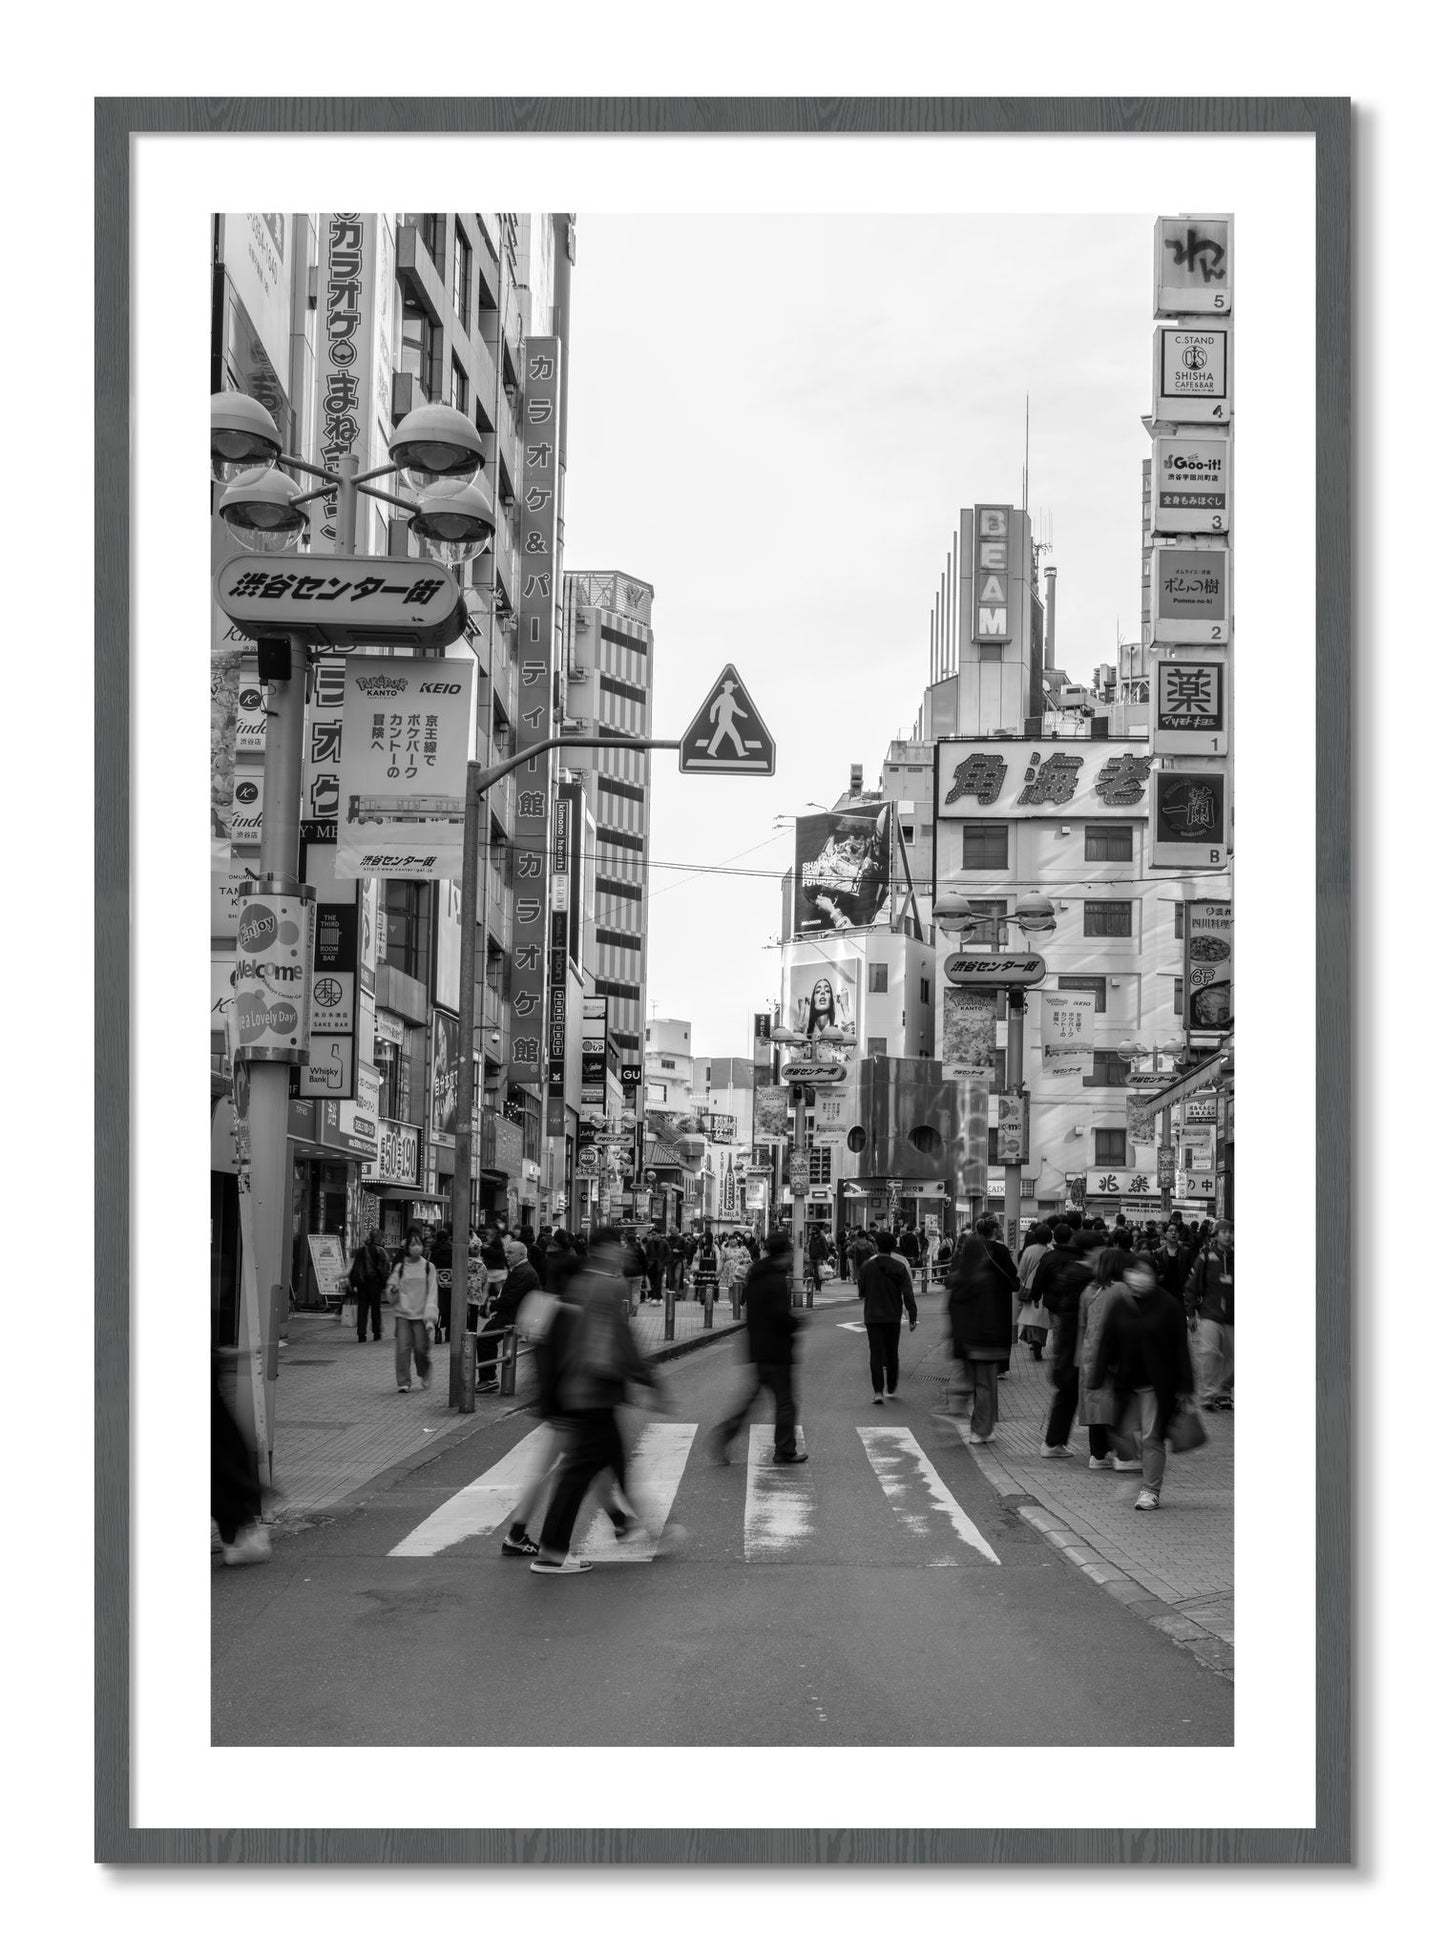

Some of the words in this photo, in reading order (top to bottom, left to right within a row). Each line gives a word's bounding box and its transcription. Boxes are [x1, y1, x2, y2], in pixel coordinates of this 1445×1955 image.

[328, 221, 364, 341] カラオケ
[1214, 295, 1224, 307] 5
[1175, 336, 1214, 344] C.STAND
[1175, 372, 1214, 380] SHISHA
[1213, 405, 1223, 418] 4
[1174, 456, 1221, 470] Goo-it!
[1163, 496, 1222, 505] 全身もみほぐし
[1212, 515, 1222, 529] 3
[980, 507, 1008, 635] BEAM
[228, 572, 445, 605] 渋谷センター街
[1164, 577, 1219, 594] ポムの樹
[1211, 626, 1221, 640] 2
[420, 682, 462, 694] KEIO
[1167, 668, 1211, 712] 薬
[1162, 715, 1216, 728] マツモトキヨシ
[387, 714, 402, 778] カントーの
[424, 715, 439, 766] 京王線で
[1211, 738, 1218, 751] 1
[1162, 786, 1215, 828] 一蘭
[557, 804, 566, 835] kimono
[360, 855, 437, 866] 渋谷センター街
[556, 839, 565, 870] hearts
[1210, 850, 1220, 863] B
[240, 916, 275, 945] Enjoy
[1192, 918, 1230, 929] 四川料理
[513, 853, 543, 1064] カラオケ館
[951, 960, 1040, 972] 渋谷センター街
[1190, 969, 1215, 985] 6F
[251, 1009, 278, 1028] Lovely
[279, 1010, 297, 1023] Day!
[310, 1067, 338, 1076] Whisky
[623, 1070, 641, 1079] GU
[784, 1067, 838, 1075] 渋谷センター街
[1099, 1174, 1150, 1193] 兆楽
